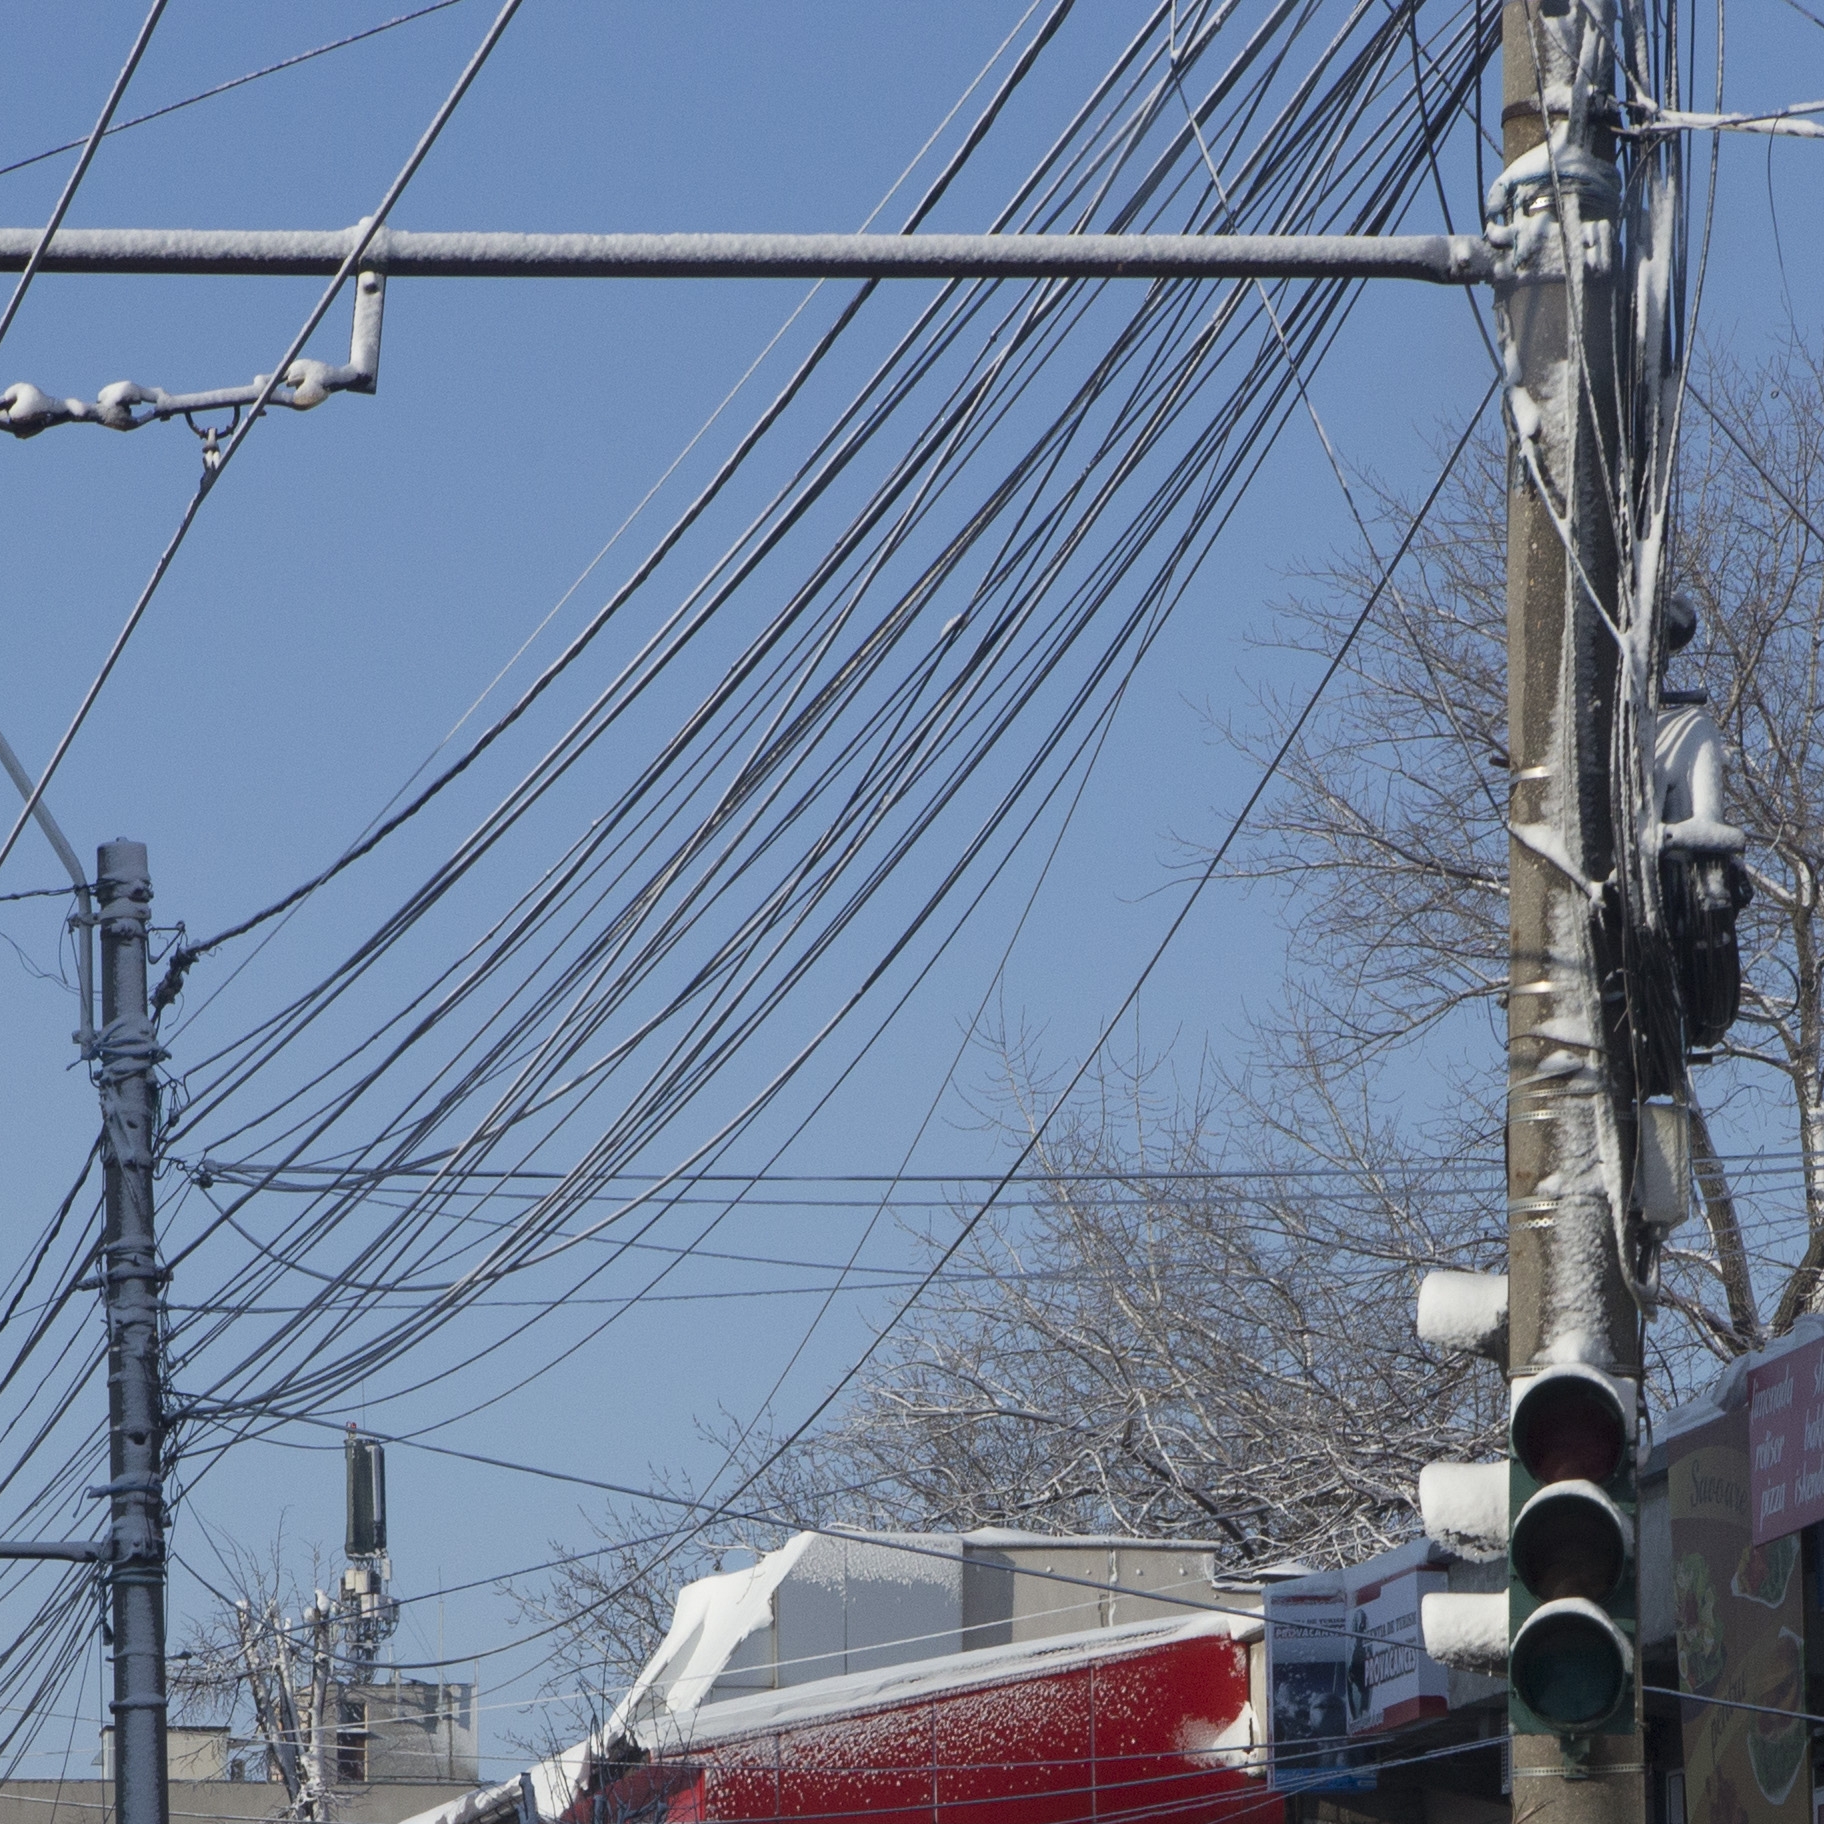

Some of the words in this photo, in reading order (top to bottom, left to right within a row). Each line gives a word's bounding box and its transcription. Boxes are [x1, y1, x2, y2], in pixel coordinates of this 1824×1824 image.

[1751, 1363, 1793, 1425] limonada
[1759, 1479, 1786, 1532] pizza
[1275, 1626, 1345, 1639] PROVACAN
